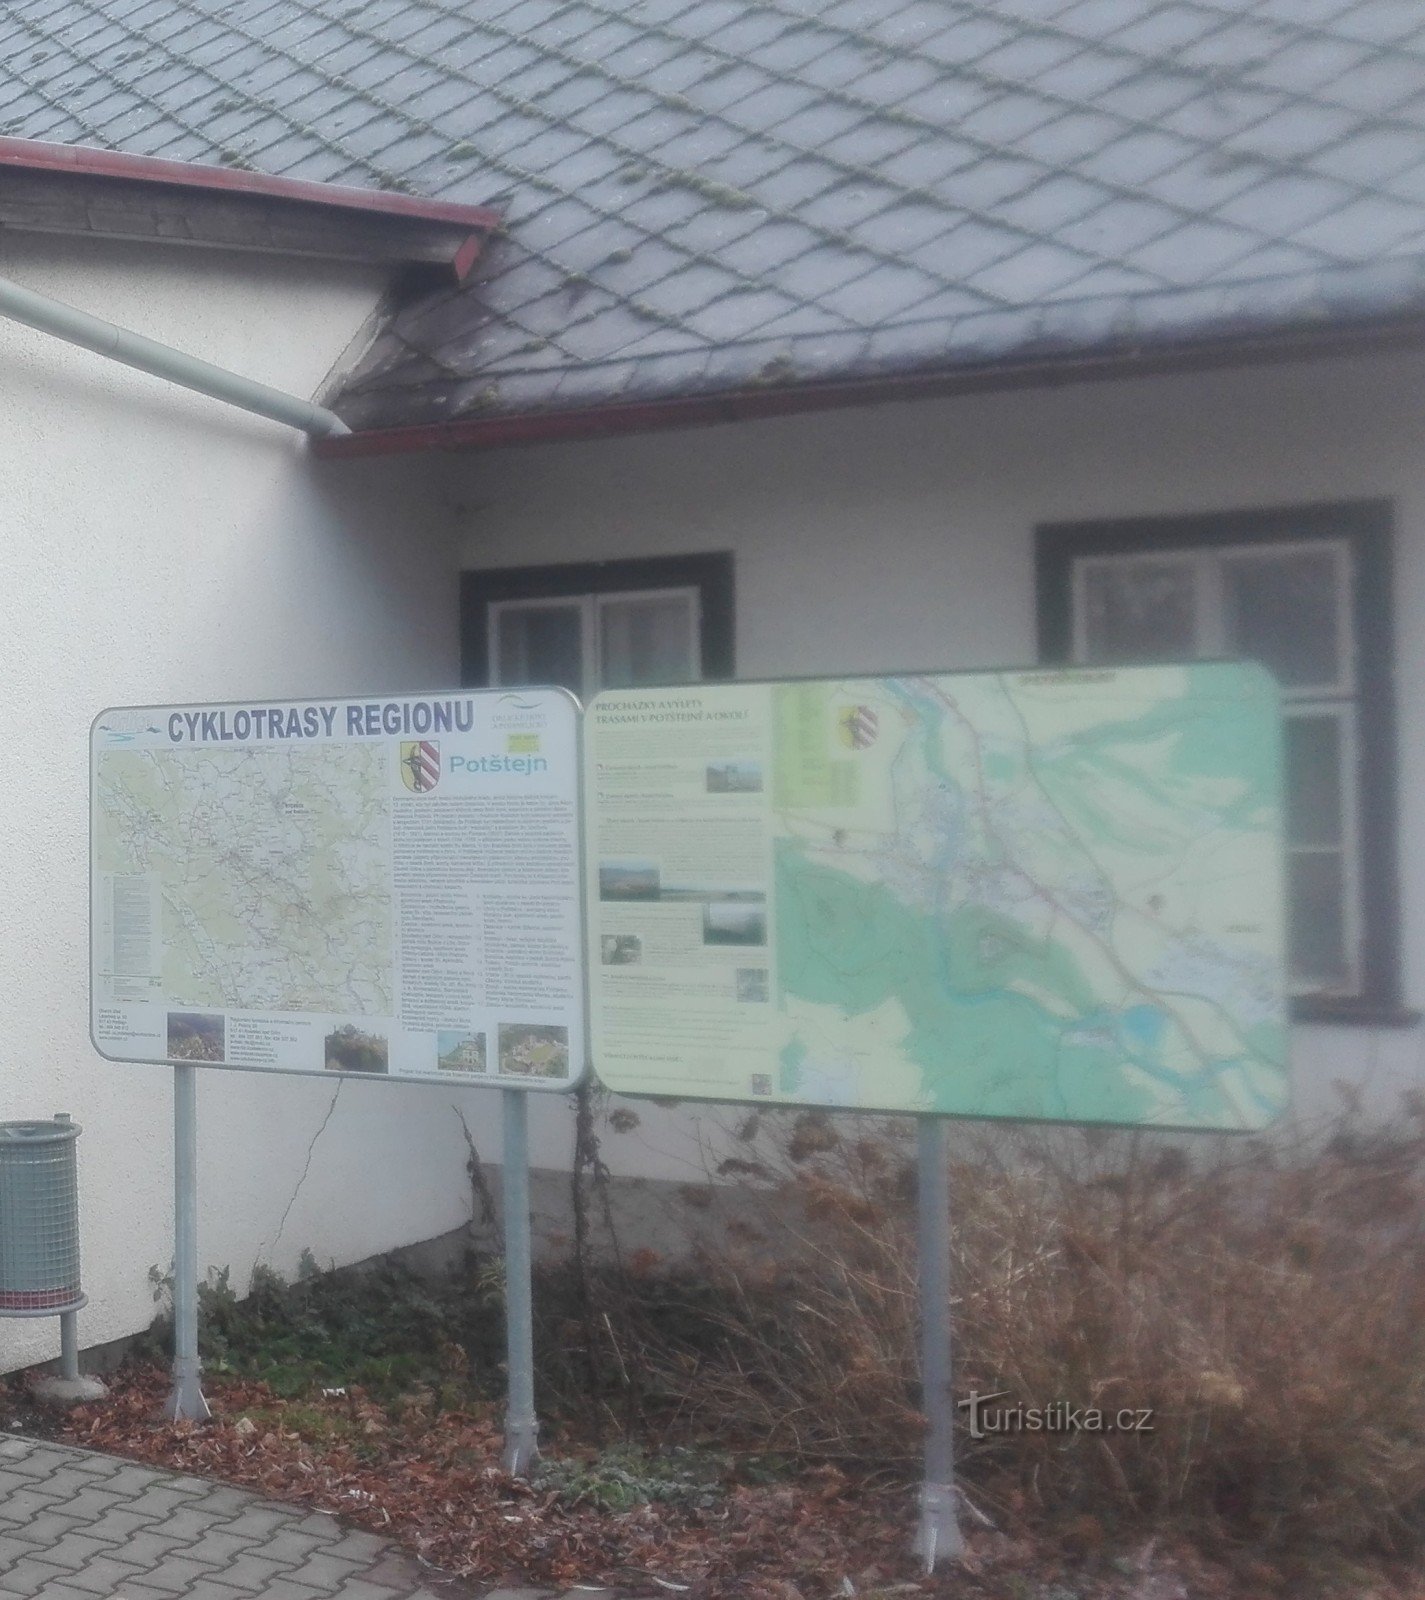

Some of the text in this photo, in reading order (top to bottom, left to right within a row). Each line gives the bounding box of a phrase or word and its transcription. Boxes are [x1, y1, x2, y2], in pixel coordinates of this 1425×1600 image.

[168, 700, 474, 742] CYKLOTRASY REGIONU
[450, 752, 548, 776] Potštejn
